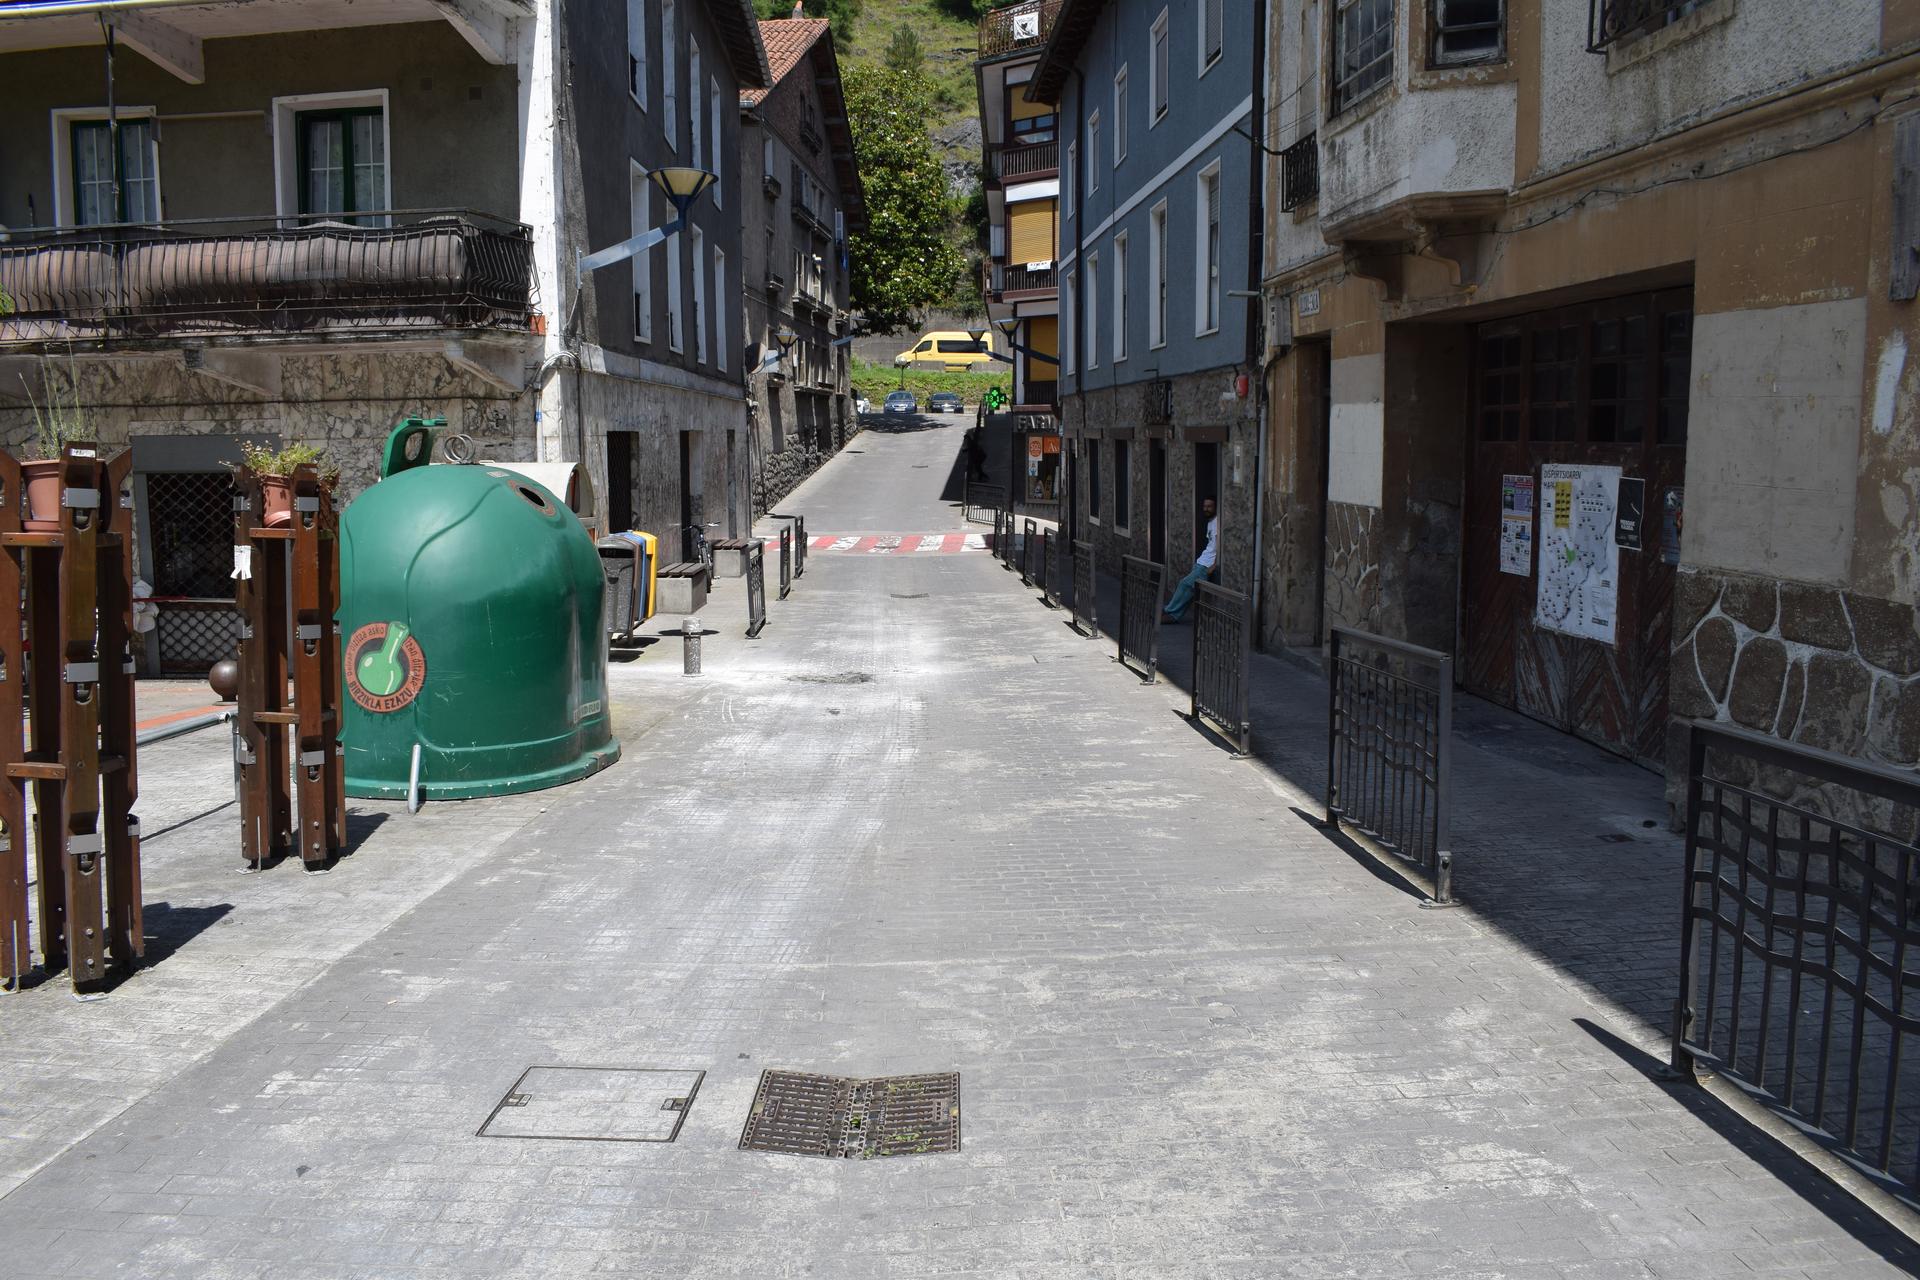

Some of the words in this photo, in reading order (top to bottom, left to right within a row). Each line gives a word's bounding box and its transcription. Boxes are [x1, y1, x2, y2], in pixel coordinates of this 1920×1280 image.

[368, 625, 385, 635] asko
[349, 680, 382, 710] BIRZIKLA
[384, 687, 414, 710] EZAZU
